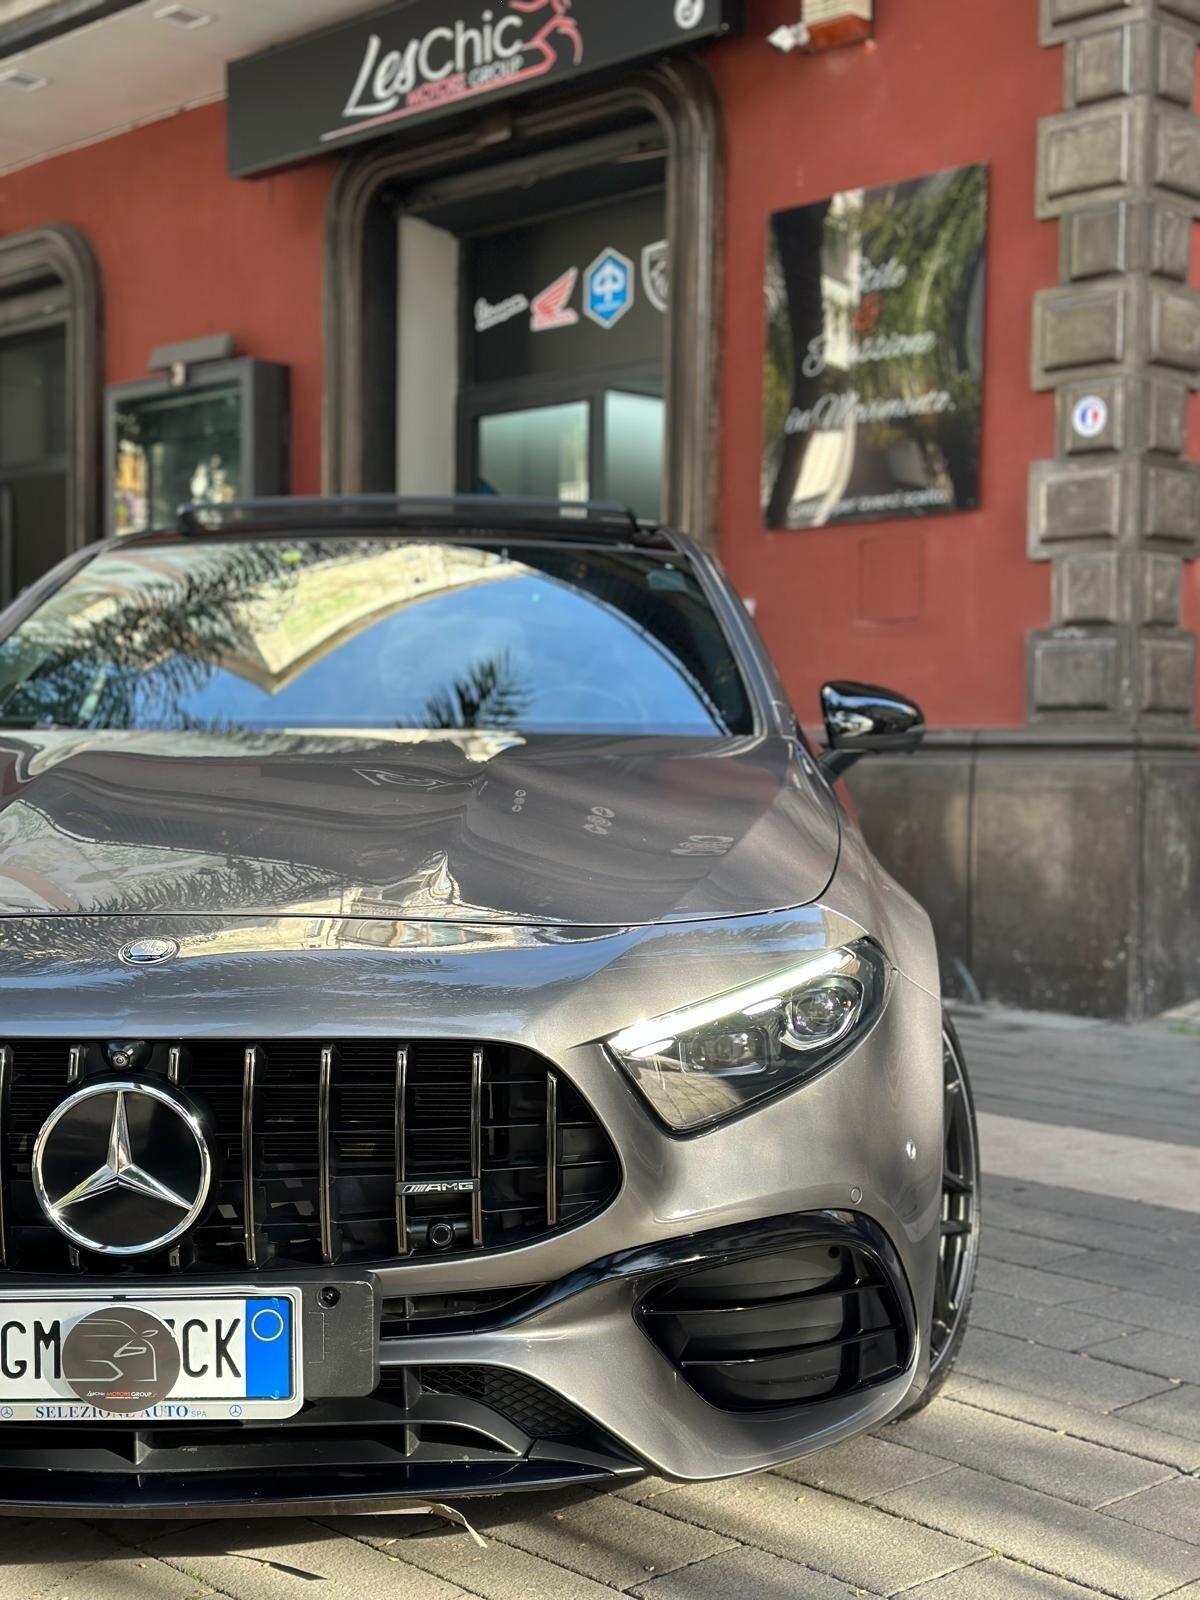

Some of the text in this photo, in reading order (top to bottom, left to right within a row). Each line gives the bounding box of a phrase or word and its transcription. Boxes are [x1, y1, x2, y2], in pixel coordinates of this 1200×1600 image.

[467, 54, 525, 88] GROUP
[424, 1182, 474, 1192] AMG
[130, 1390, 153, 1398] GROUP
[190, 1409, 207, 1418] SPA
